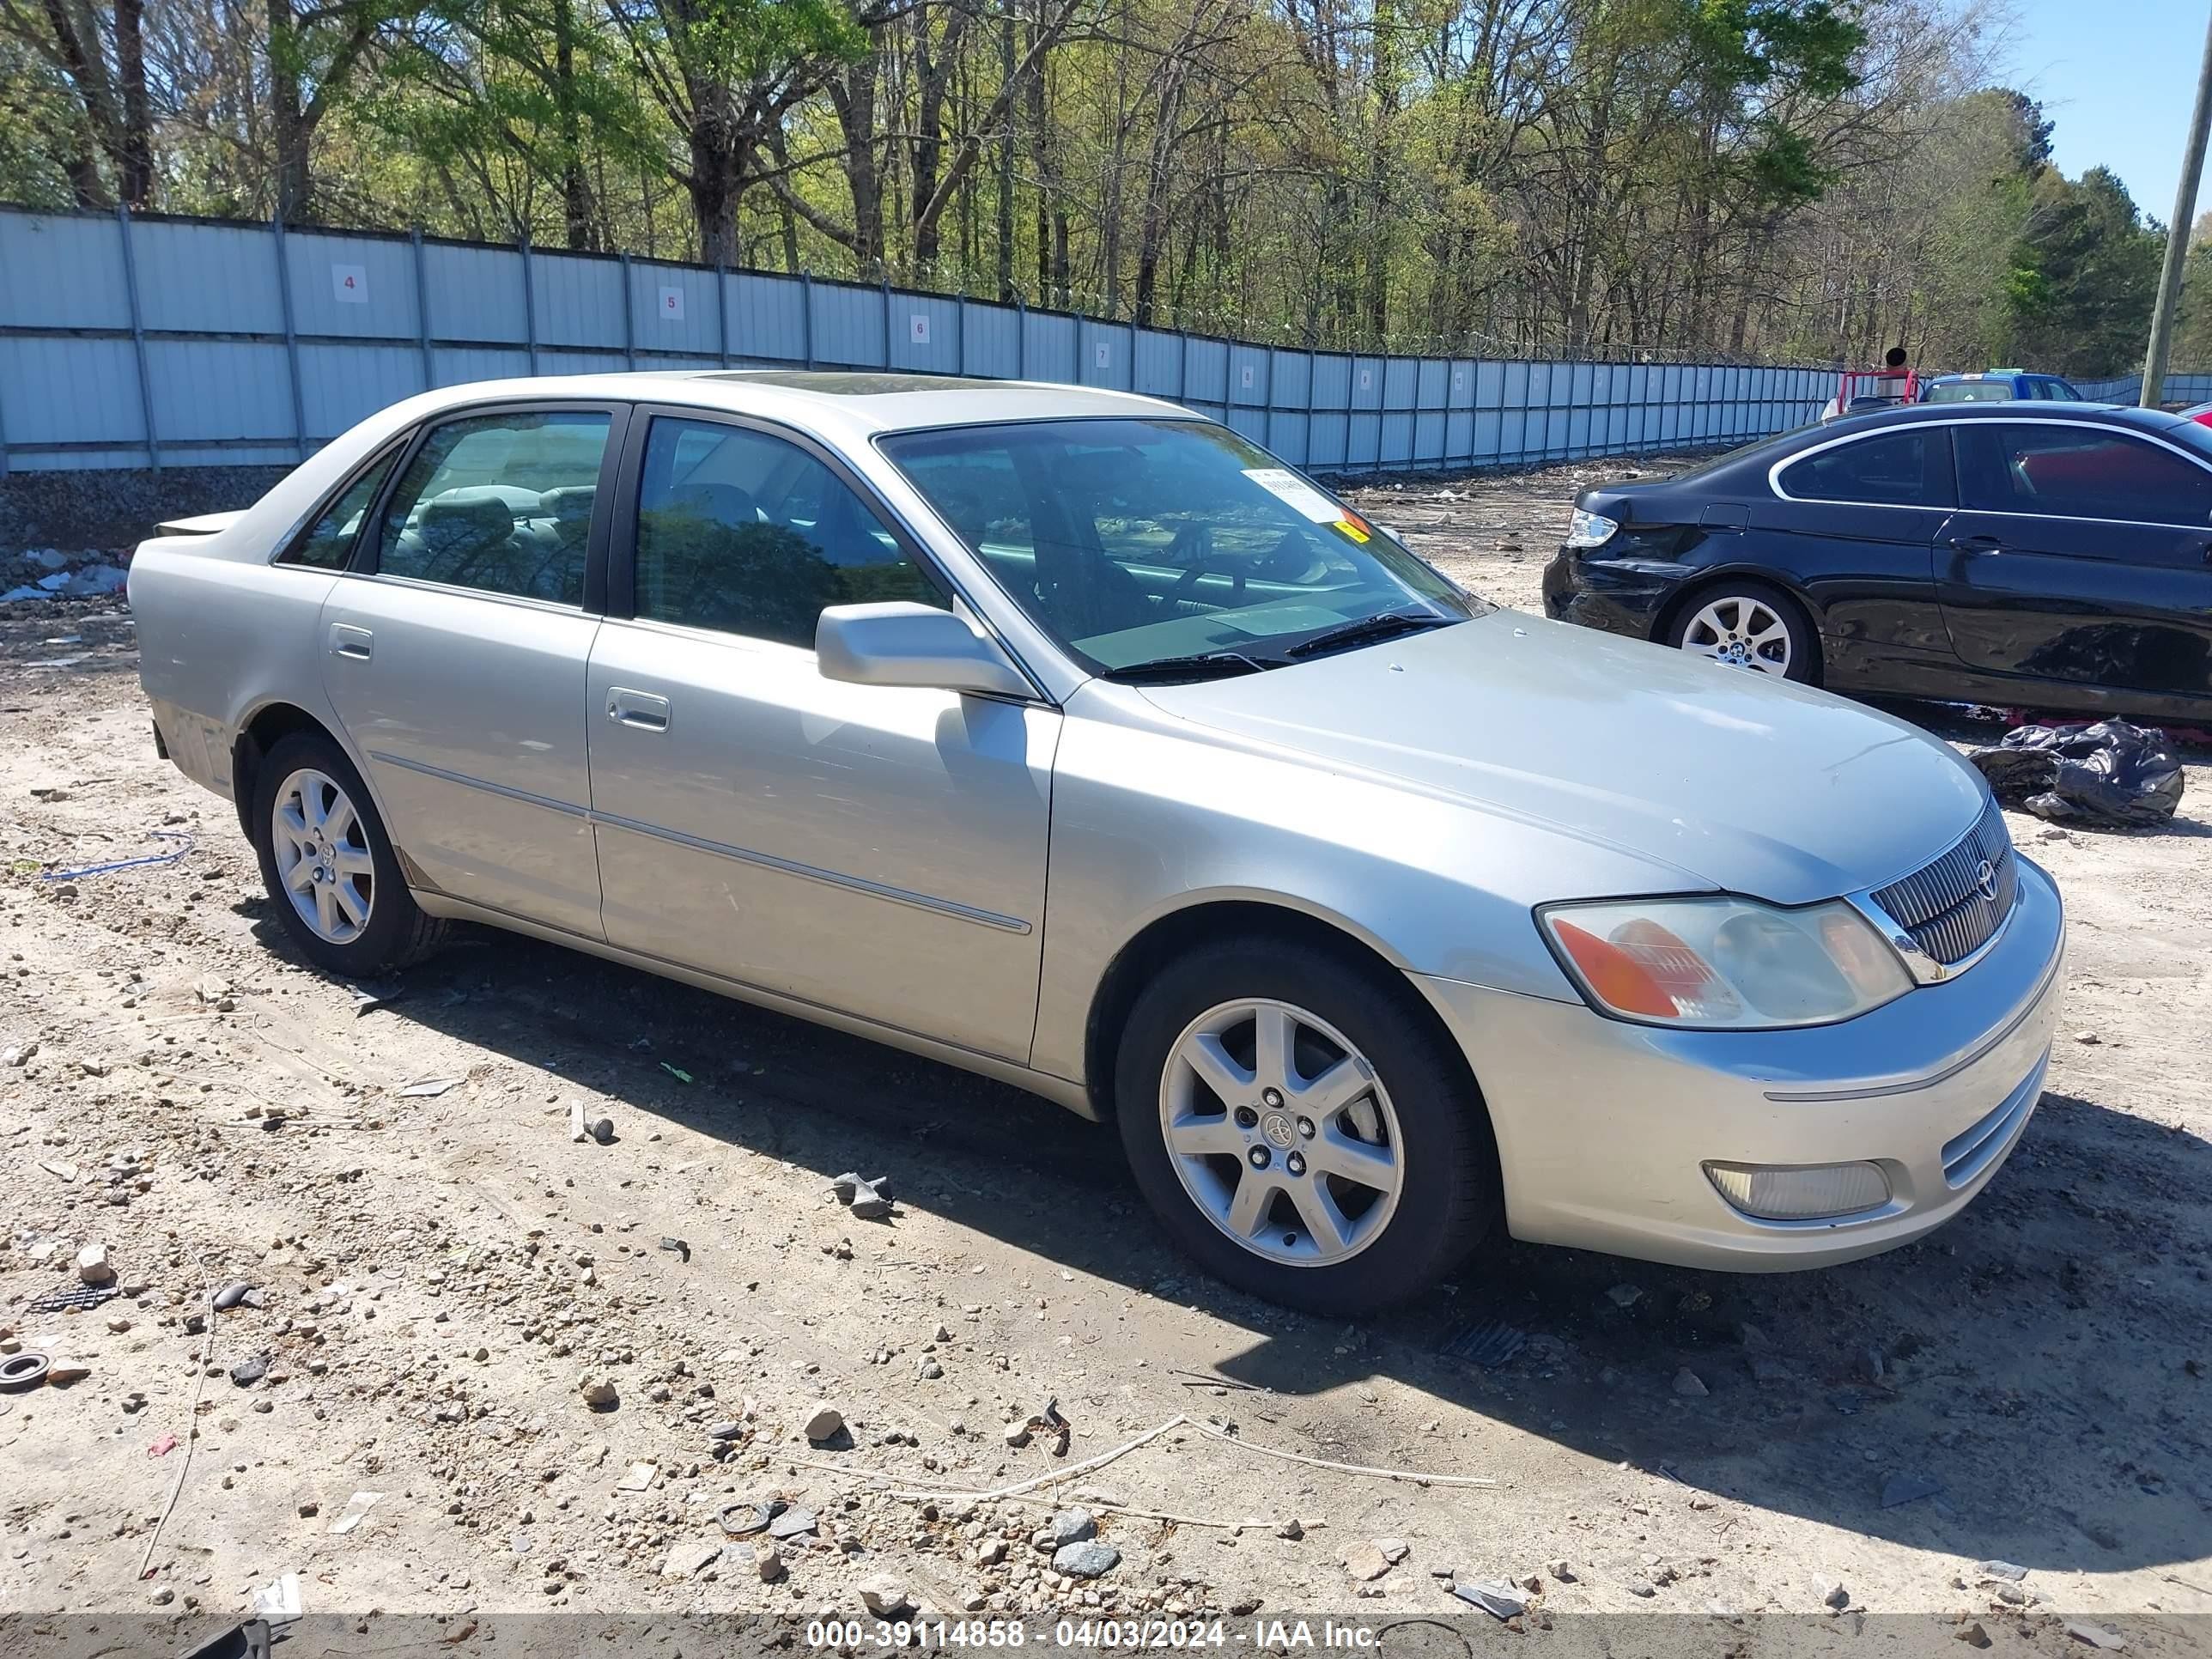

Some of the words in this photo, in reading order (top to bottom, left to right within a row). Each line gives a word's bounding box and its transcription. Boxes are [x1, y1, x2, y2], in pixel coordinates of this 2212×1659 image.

[344, 276, 356, 289] 4
[667, 296, 676, 308] 5
[916, 323, 924, 334] 6
[1100, 349, 1105, 360] 7
